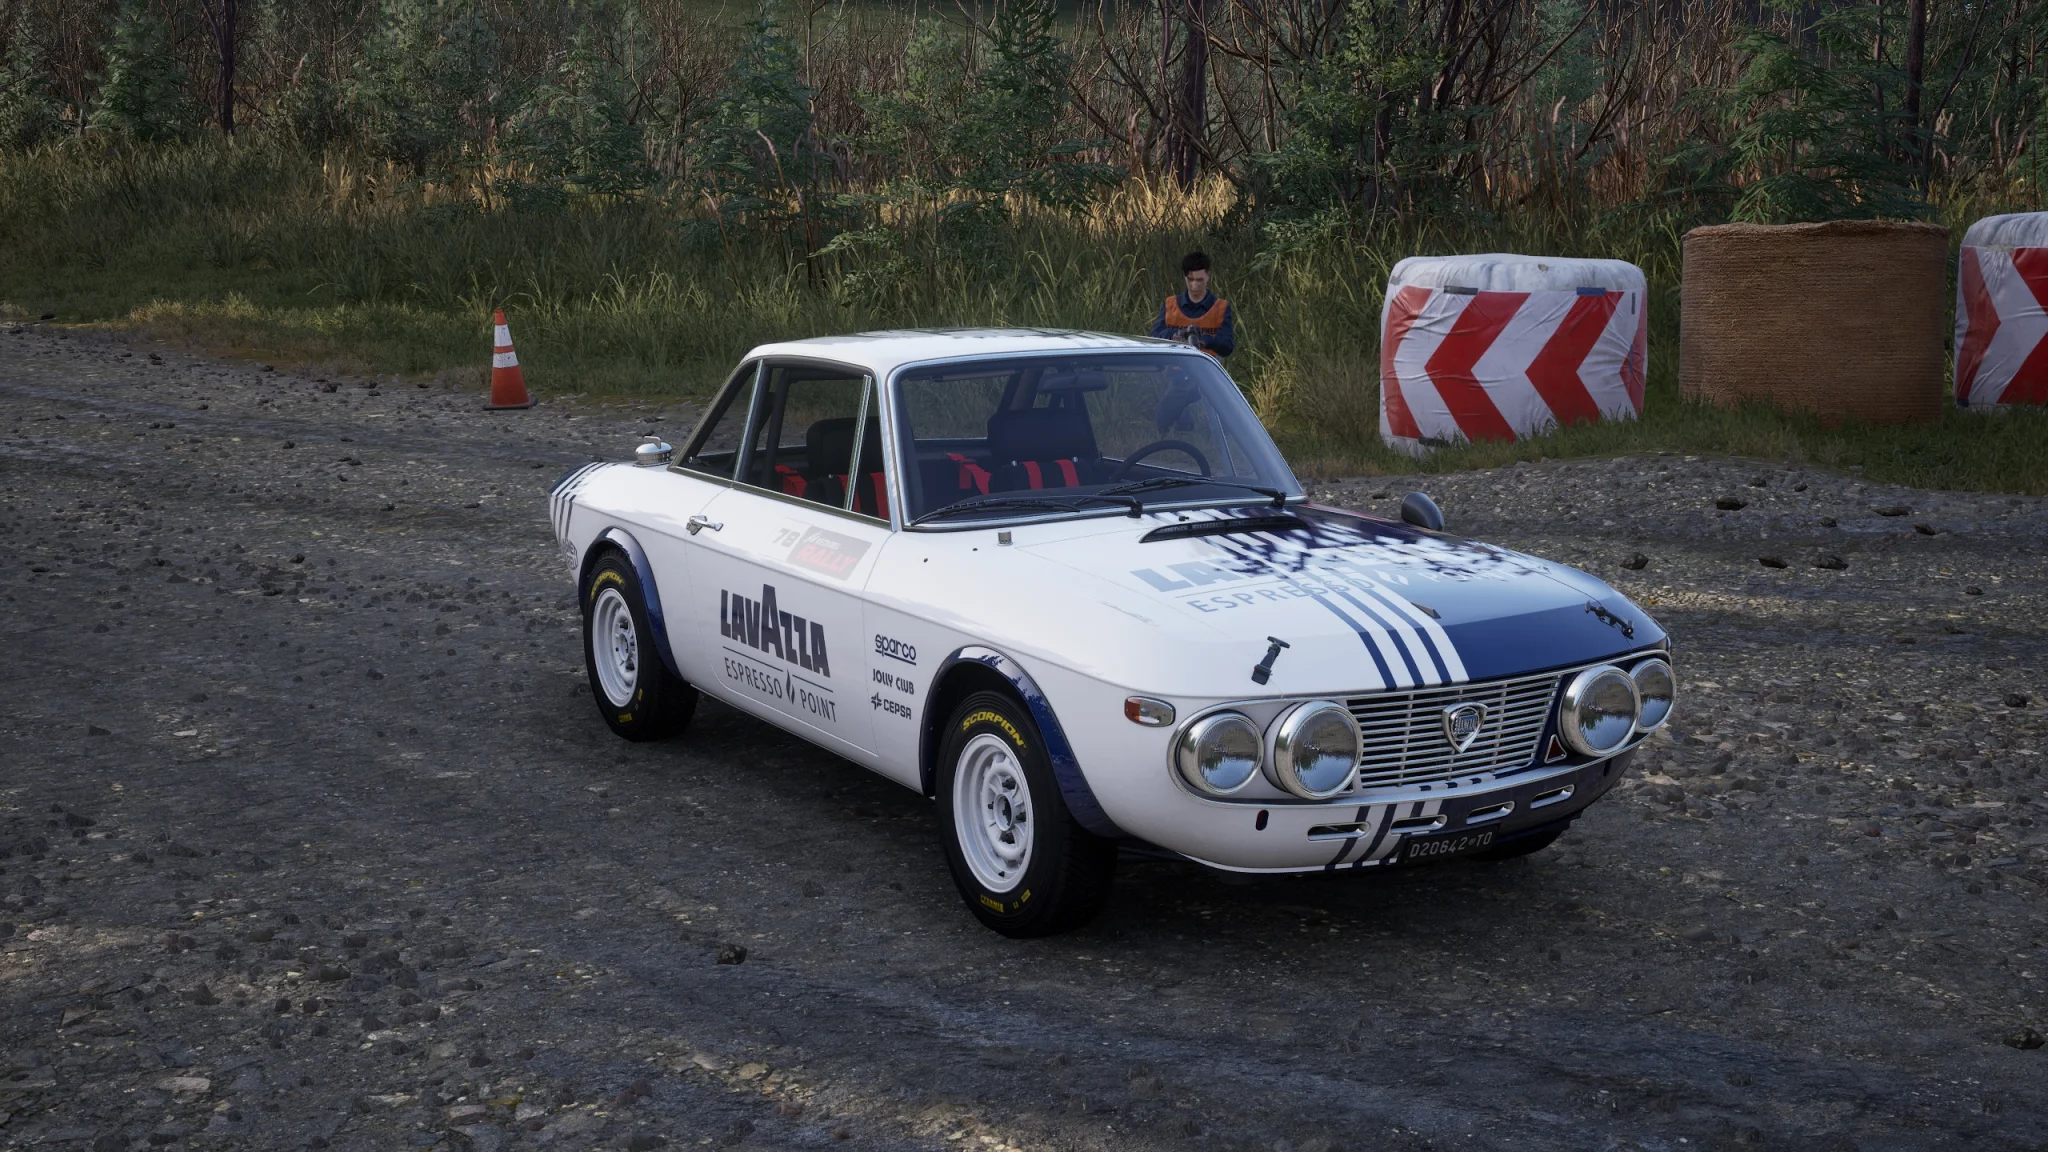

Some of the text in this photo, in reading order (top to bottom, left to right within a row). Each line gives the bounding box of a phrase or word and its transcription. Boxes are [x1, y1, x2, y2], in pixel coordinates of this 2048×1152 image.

[1186, 577, 1375, 613] ESPRESSO
[720, 583, 831, 678] LAVAZZA
[875, 633, 917, 661] sparco
[724, 657, 837, 723] ESPRESSO POINT
[872, 668, 915, 695] JOLLY CLUB
[883, 698, 912, 720] CEPSA
[962, 711, 1025, 746] SCORPION
